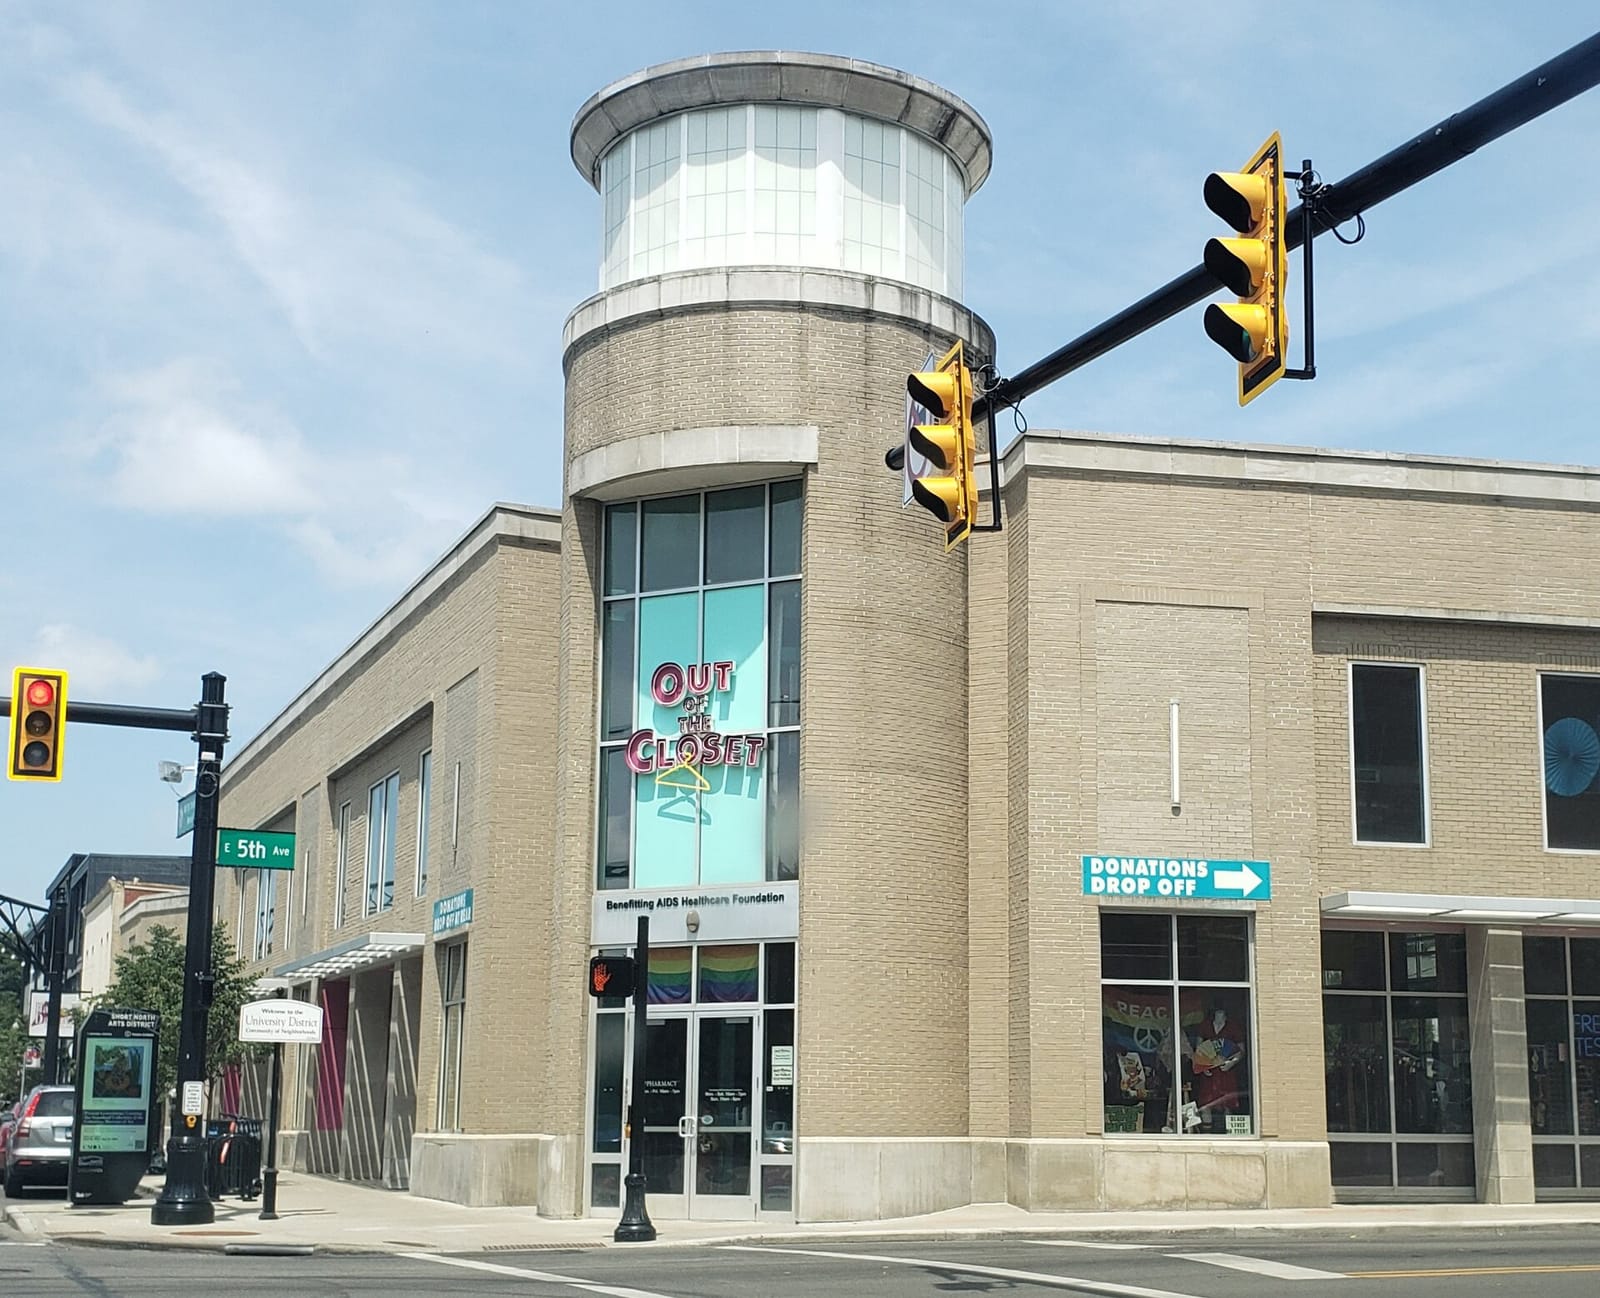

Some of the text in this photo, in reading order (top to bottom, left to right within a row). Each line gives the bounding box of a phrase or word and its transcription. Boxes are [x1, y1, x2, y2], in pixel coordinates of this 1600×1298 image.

[651, 661, 735, 708] OUT
[682, 694, 709, 713] OF
[677, 714, 714, 734] THE
[625, 728, 767, 775] CLOSET
[224, 839, 290, 859] E 5th Ave
[1090, 857, 1208, 878] DONATIONS
[1091, 876, 1197, 896] DROP OFF
[606, 892, 785, 911] Benefitting AIDS Healthcare Foundation
[133, 1013, 156, 1021] NORTH
[1116, 1000, 1168, 1019] PEAC
[126, 1021, 155, 1029] DISTRICT
[245, 1015, 318, 1028] University District
